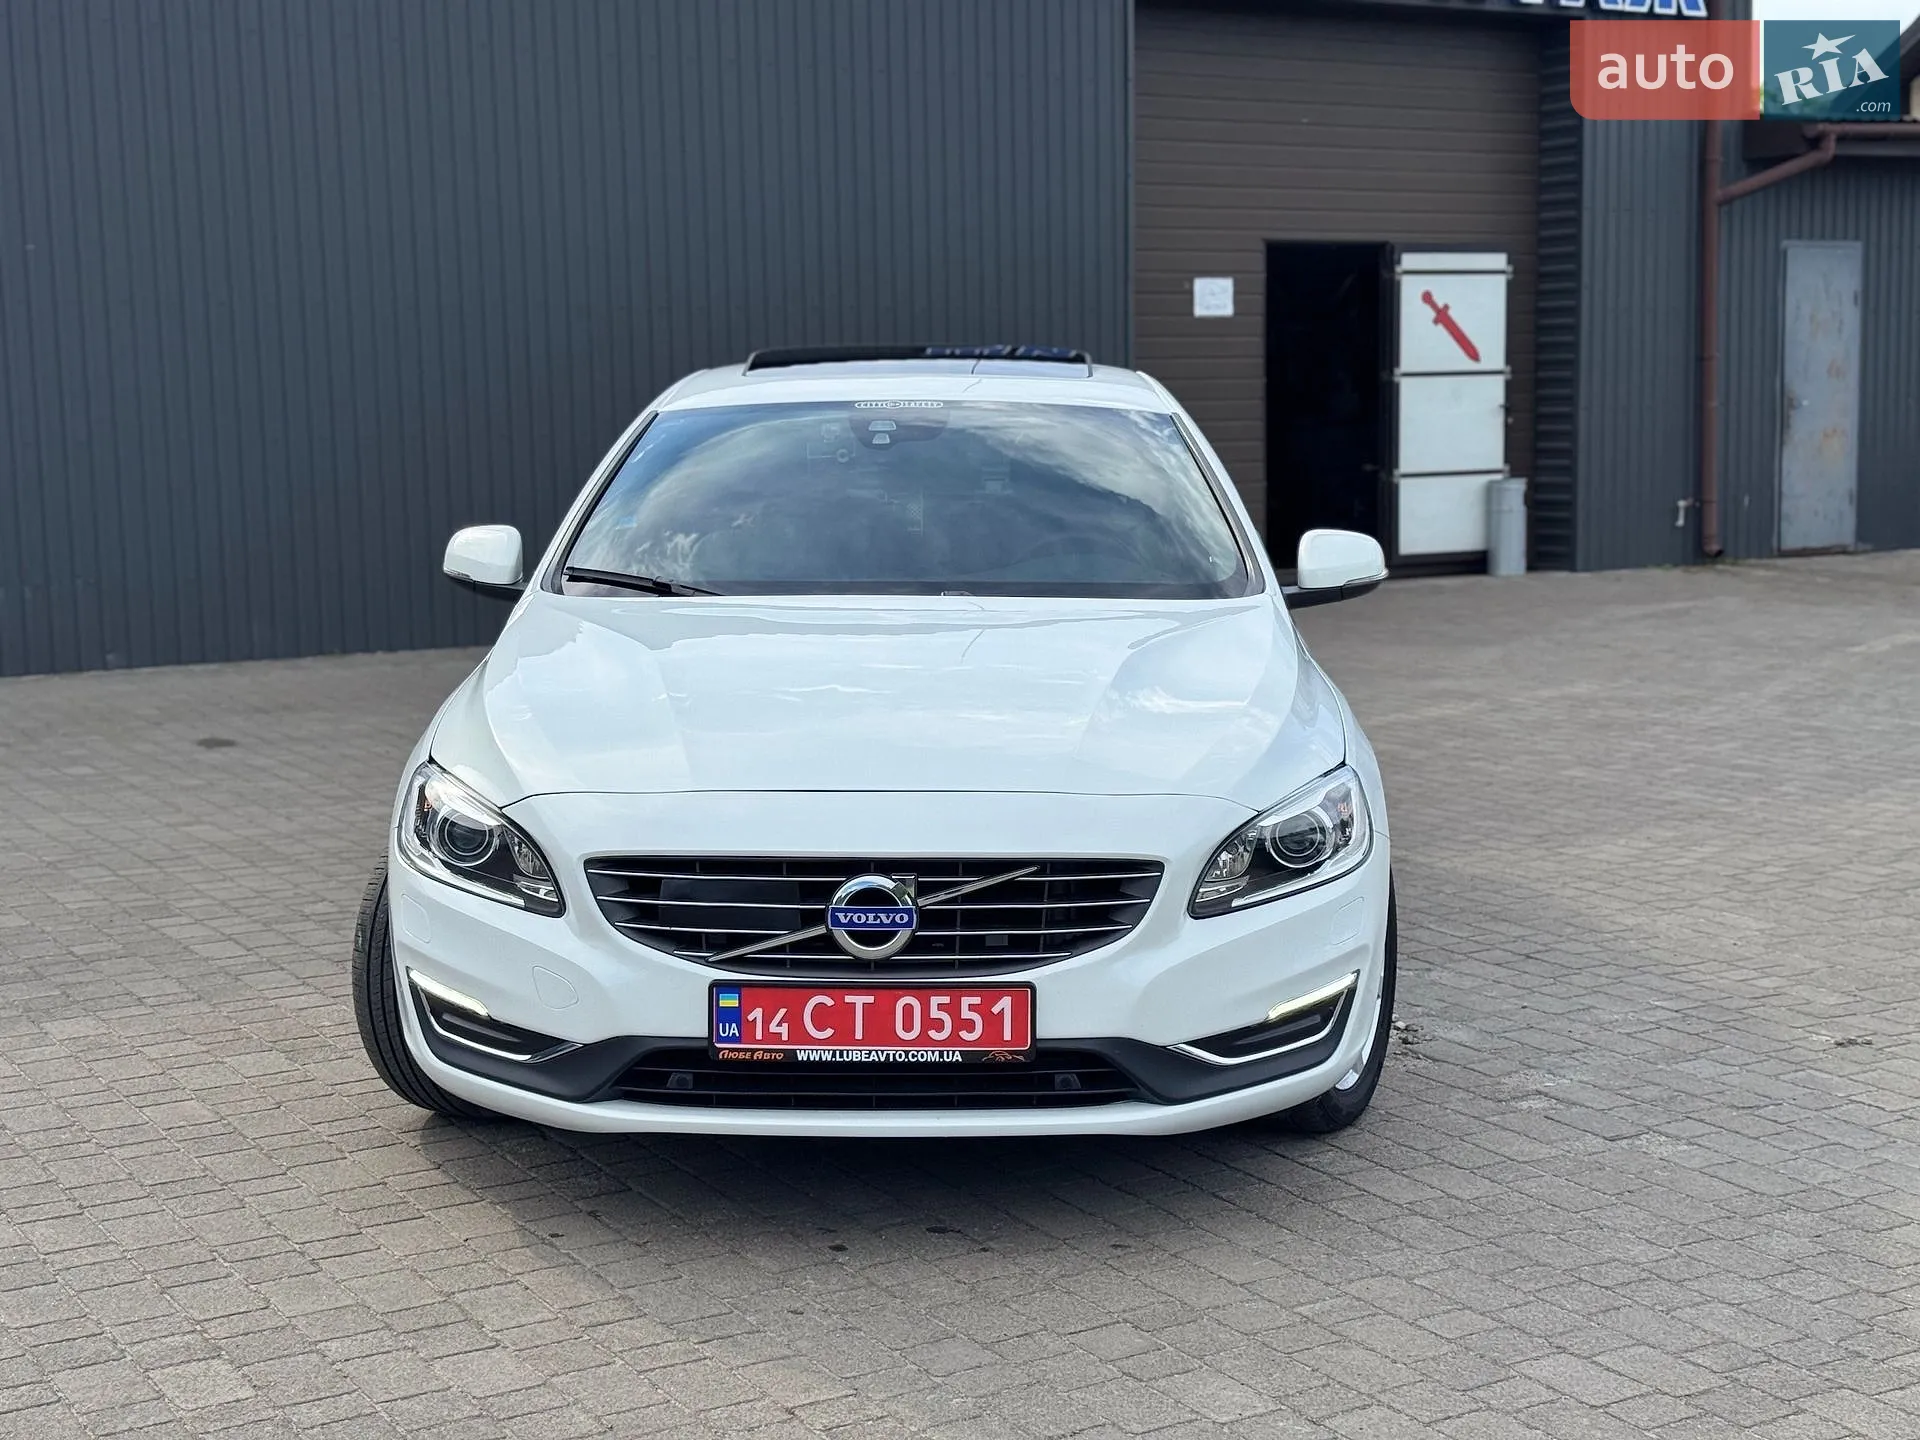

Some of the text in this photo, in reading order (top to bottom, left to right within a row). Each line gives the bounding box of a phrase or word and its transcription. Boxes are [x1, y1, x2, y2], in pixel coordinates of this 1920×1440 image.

[835, 912, 909, 924] VOLVO
[747, 1007, 789, 1041] 14
[895, 996, 1013, 1042] 0551
[719, 1023, 739, 1038] UA
[796, 1050, 963, 1063] WWW.LUBEAVTO.COM.UA
